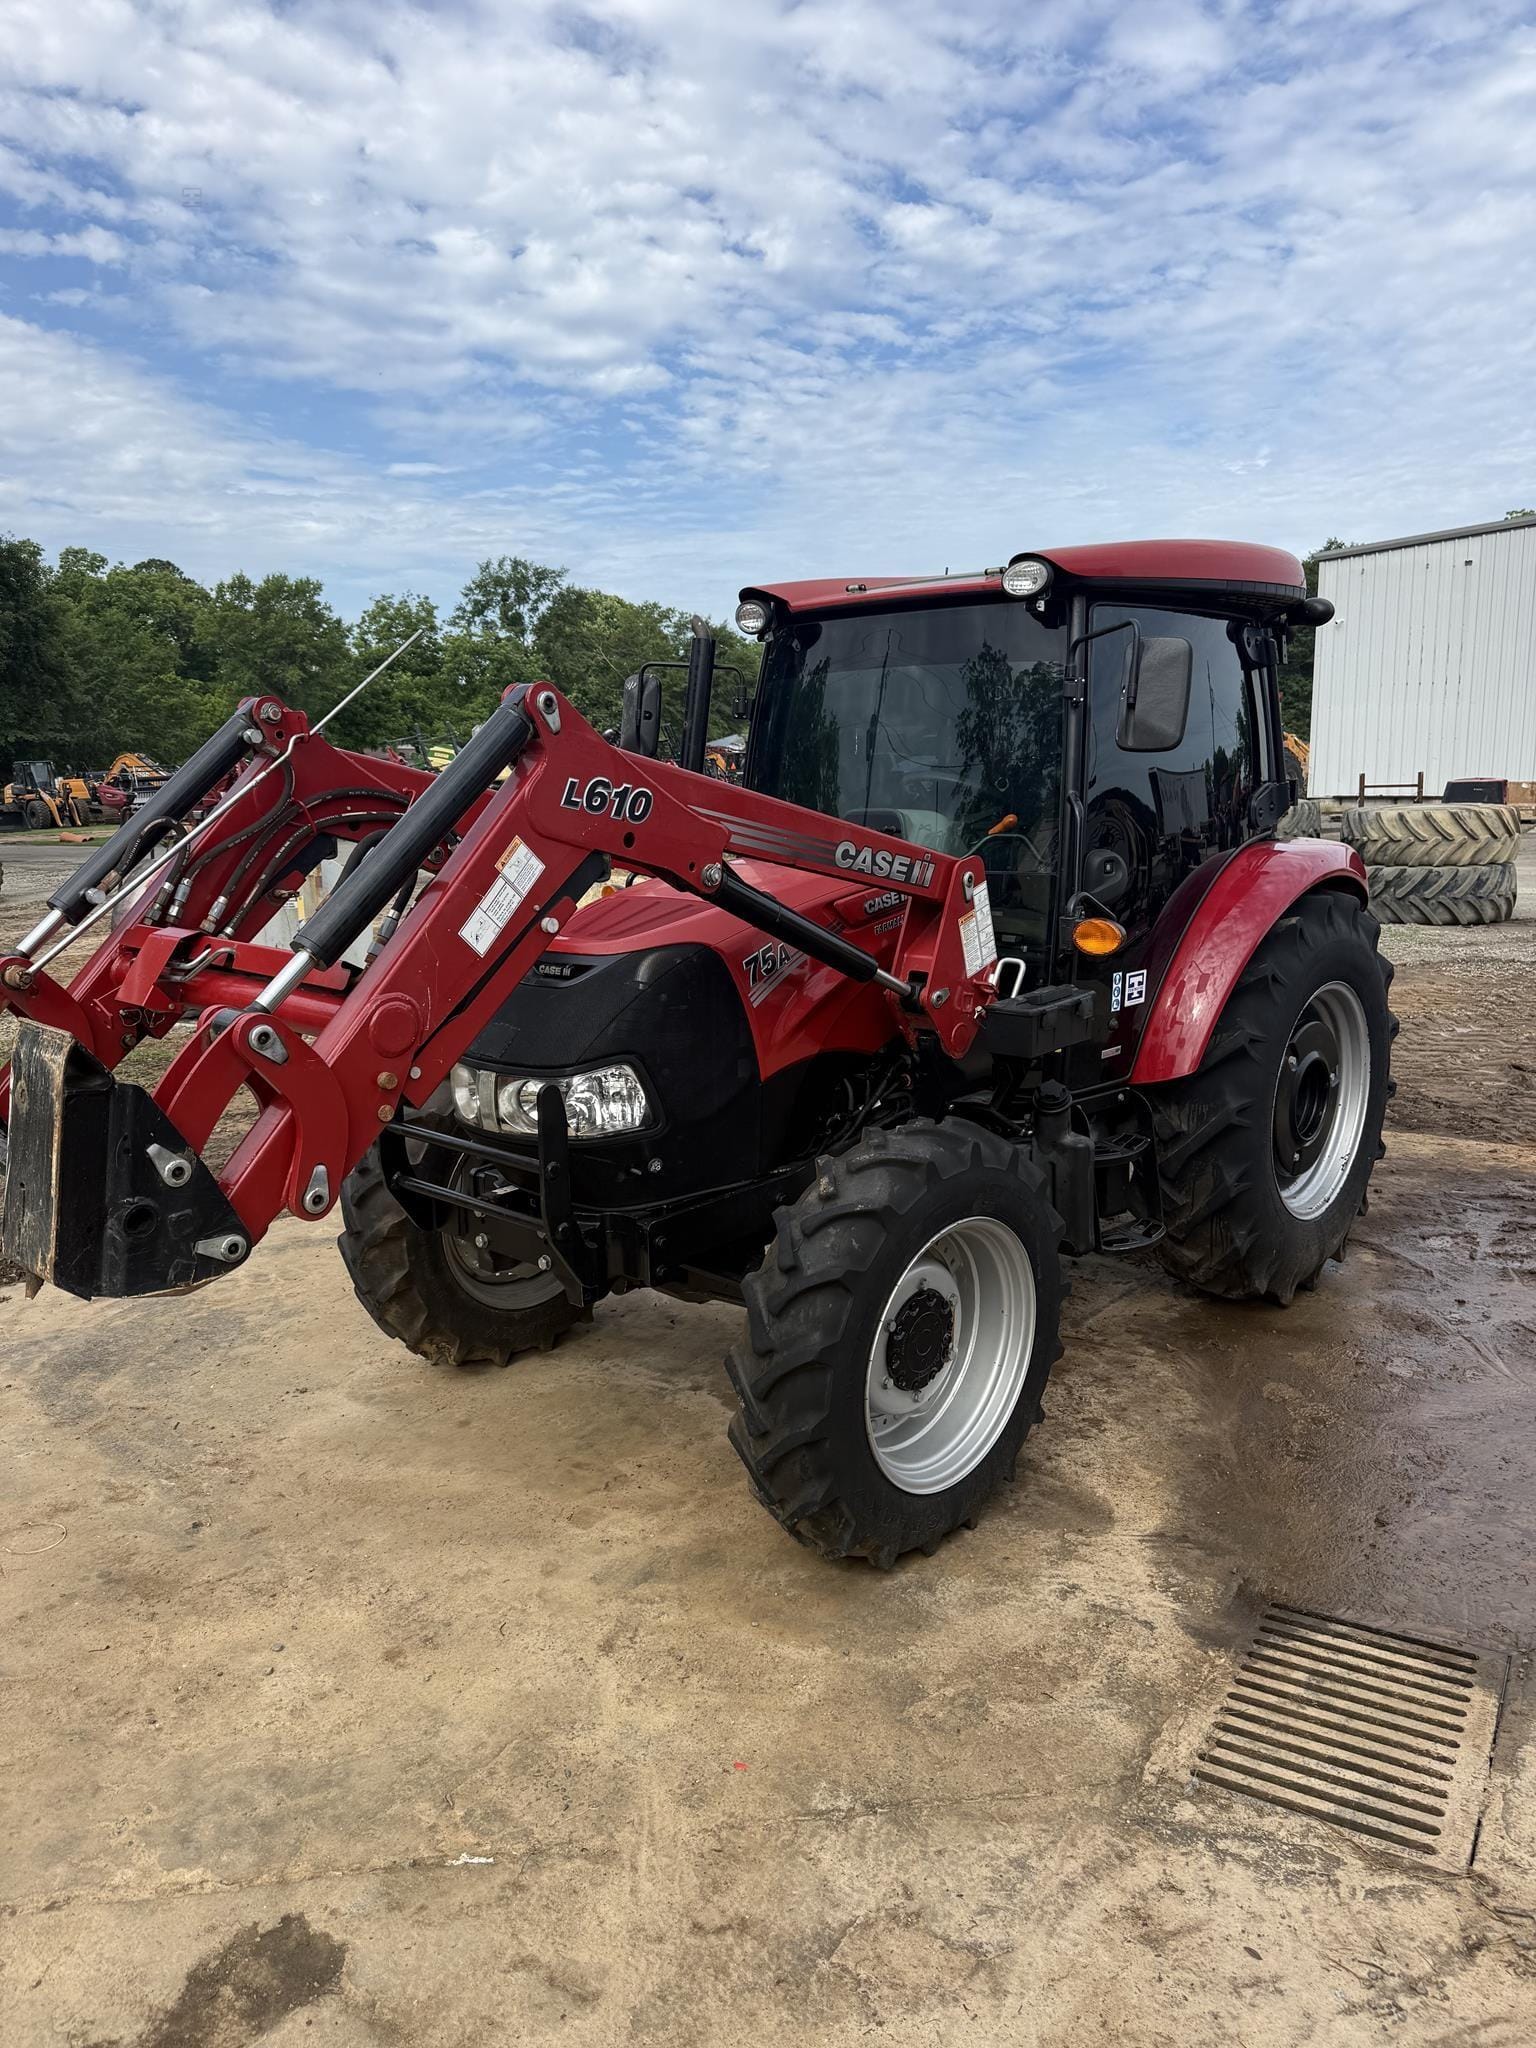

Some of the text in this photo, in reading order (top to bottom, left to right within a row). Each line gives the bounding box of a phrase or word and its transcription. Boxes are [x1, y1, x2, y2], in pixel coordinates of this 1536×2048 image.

[560, 776, 654, 824] L610
[835, 841, 911, 881] CASE
[864, 891, 900, 914] CASE
[539, 964, 561, 976] CASE
[742, 941, 793, 988] 75A
